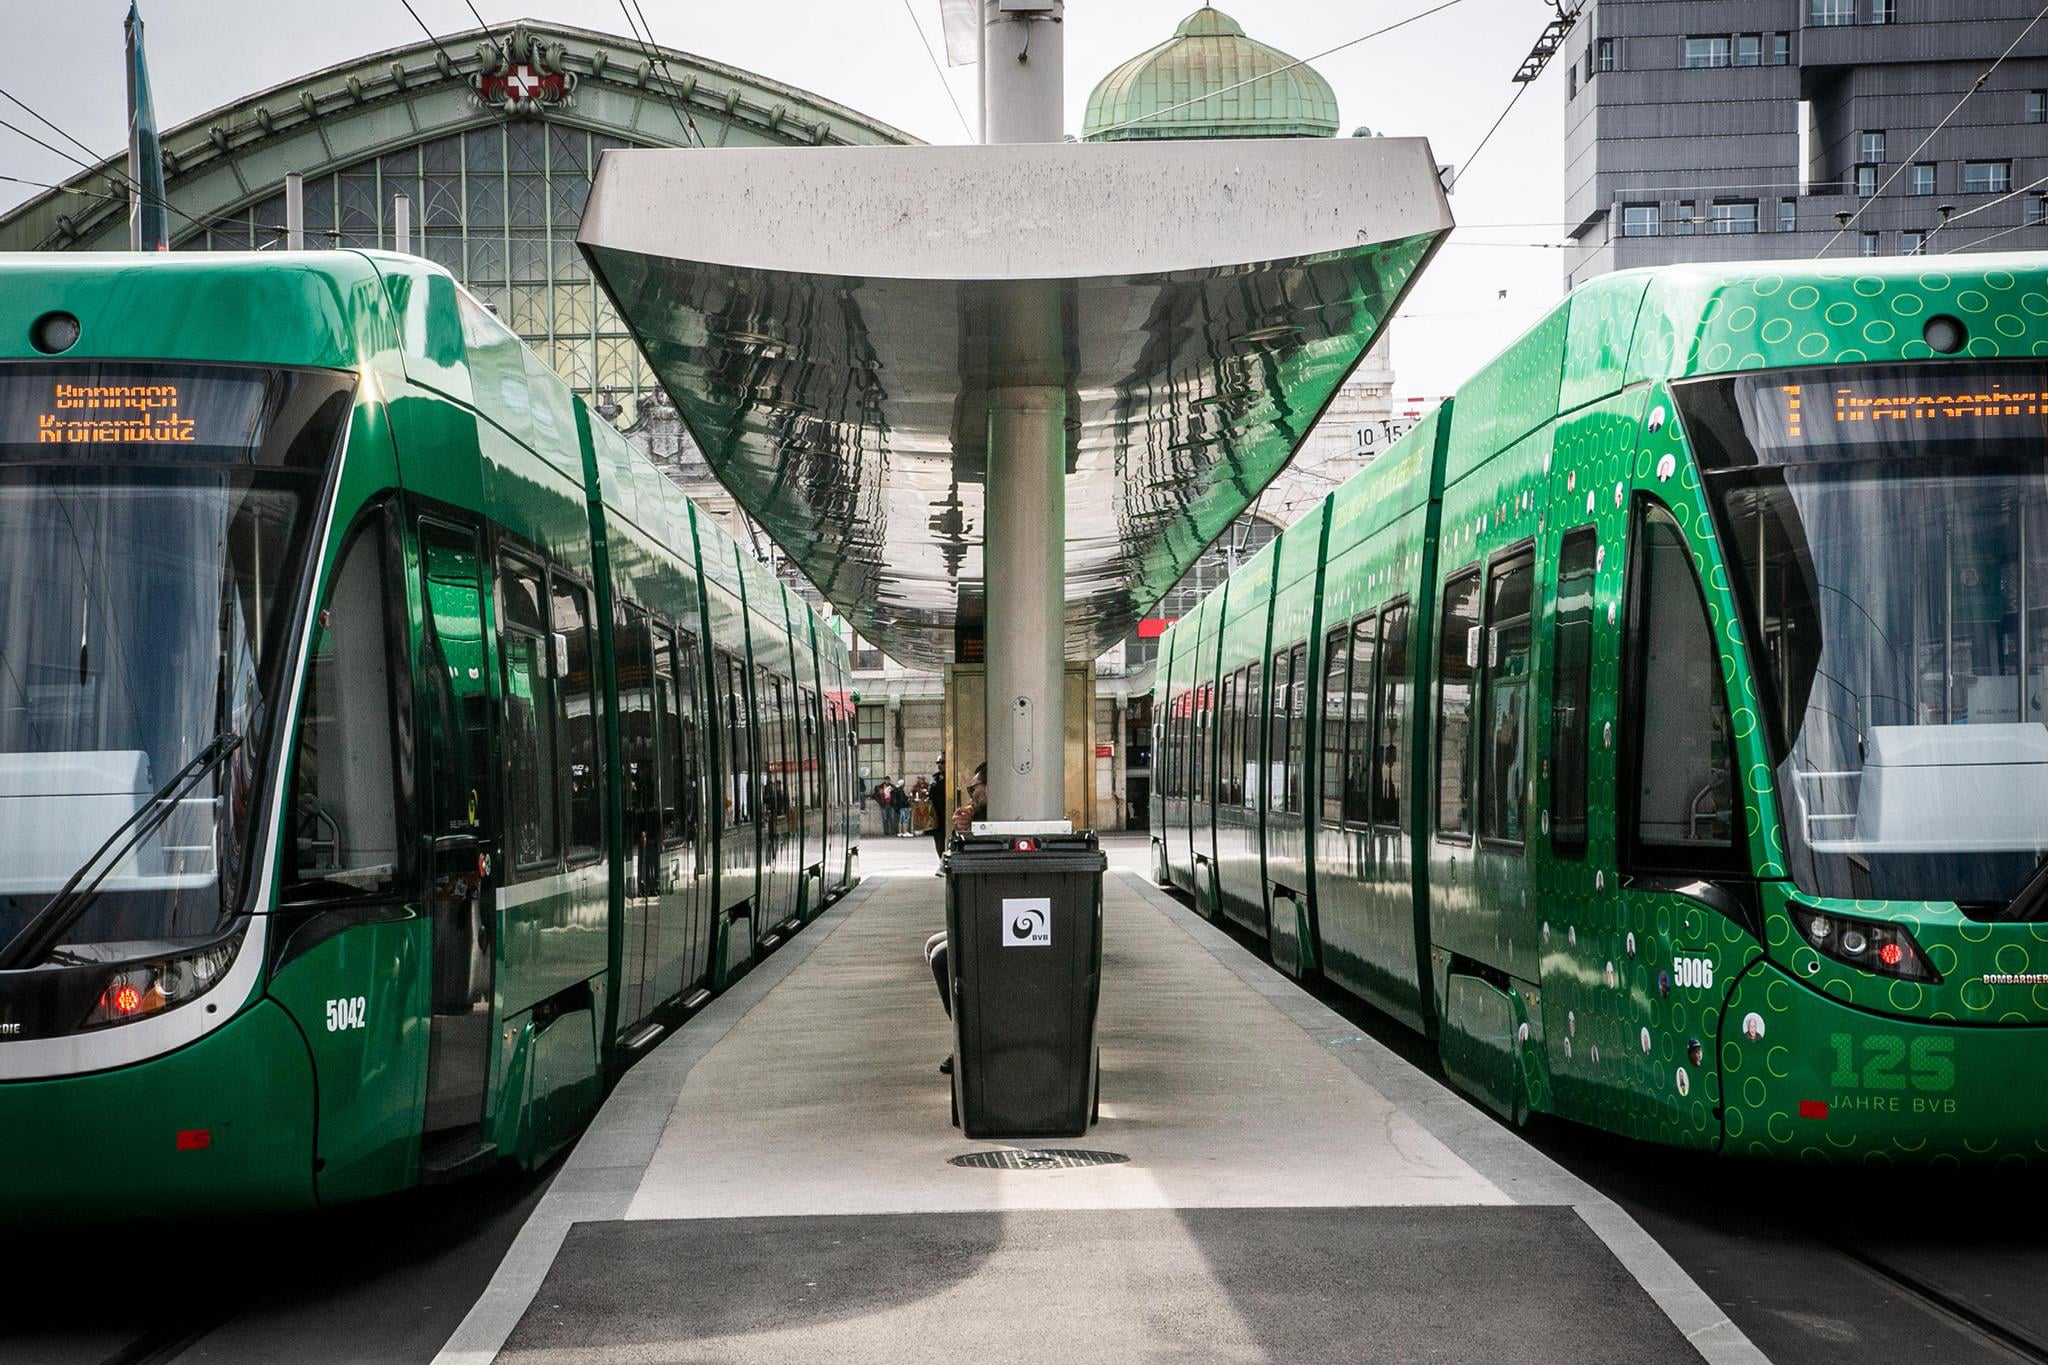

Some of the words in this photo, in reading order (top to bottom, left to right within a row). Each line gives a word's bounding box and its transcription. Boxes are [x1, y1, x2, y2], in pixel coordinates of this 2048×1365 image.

[1357, 428, 1374, 446] 10
[1386, 425, 1403, 443] 15
[1673, 957, 1713, 989] 5006
[326, 996, 365, 1032] 5042
[0, 1023, 21, 1034] DIE
[1830, 1032, 1955, 1091] 125
[1830, 1095, 1901, 1112] JAHRE
[1913, 1098, 1957, 1113] BVB
